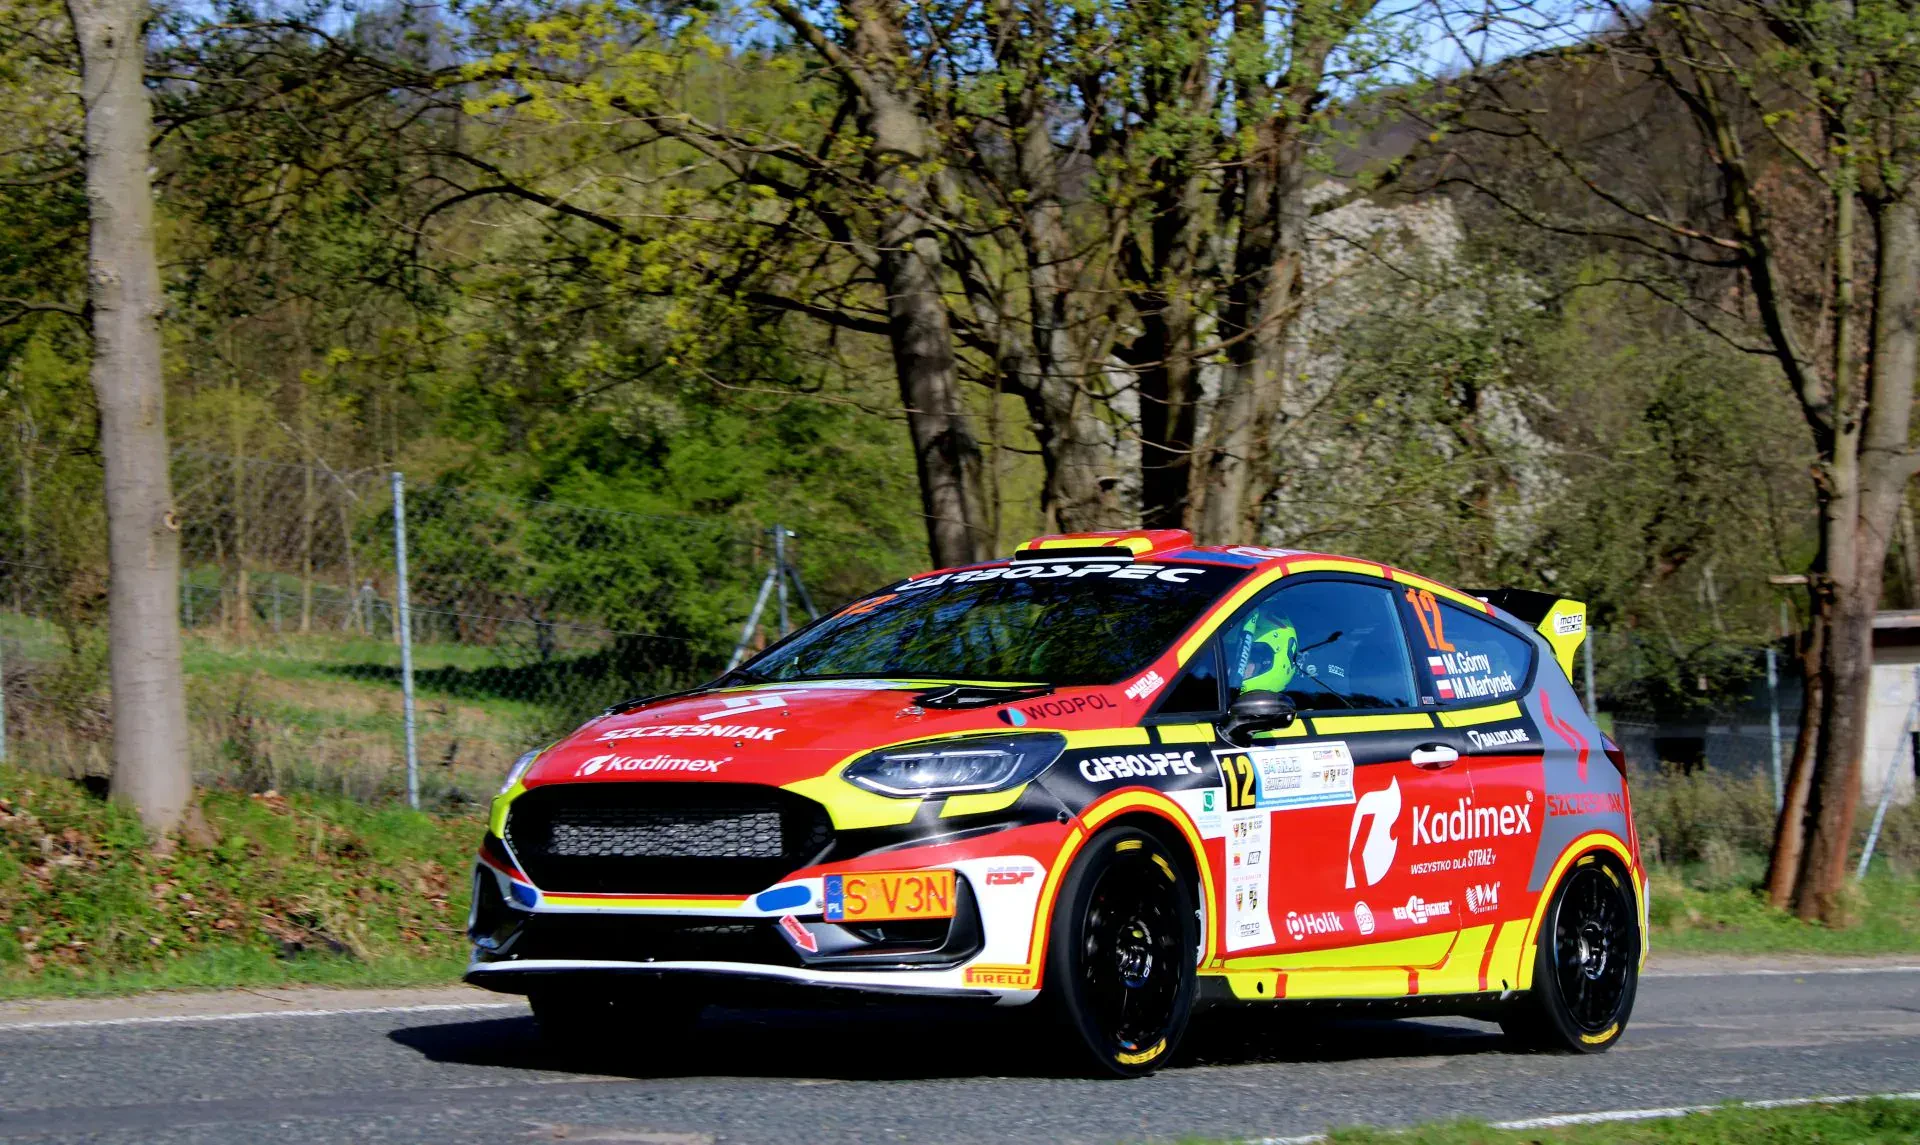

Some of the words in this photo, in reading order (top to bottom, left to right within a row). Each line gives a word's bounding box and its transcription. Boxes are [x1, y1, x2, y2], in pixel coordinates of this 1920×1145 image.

[894, 563, 1205, 593] CARBOSPEC
[1405, 588, 1455, 652] 12
[1442, 651, 1491, 675] M.Górny
[1451, 671, 1517, 699] M.Martynek
[1023, 694, 1117, 720] WODPOL
[1079, 751, 1203, 782] CARBOSPEC
[1221, 755, 1255, 808] 12
[1411, 860, 1450, 875] WSZYSTKO
[1453, 857, 1467, 870] DLA
[828, 902, 842, 913] PL
[846, 879, 867, 914] S
[880, 877, 948, 913] V3N
[965, 966, 1031, 985] PIRELLI
